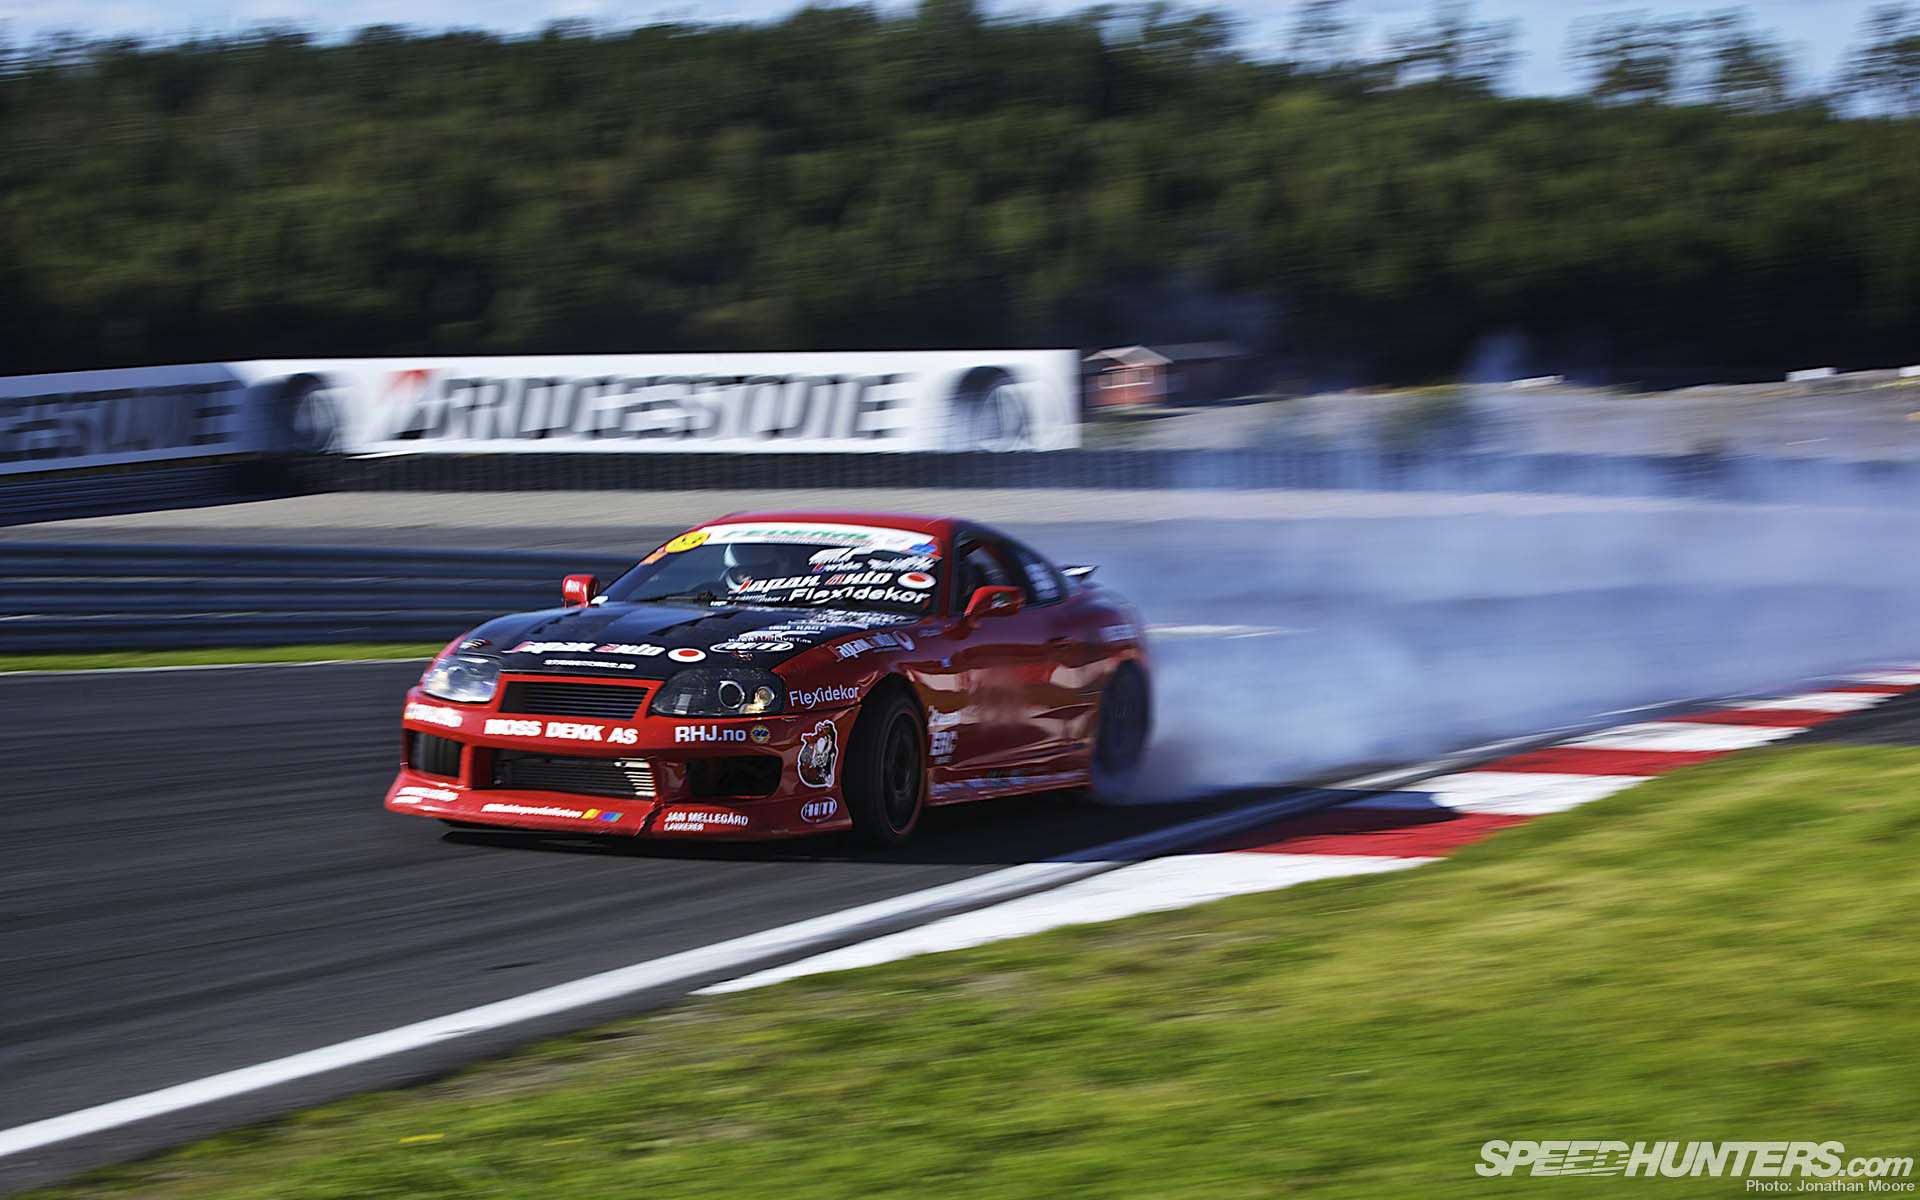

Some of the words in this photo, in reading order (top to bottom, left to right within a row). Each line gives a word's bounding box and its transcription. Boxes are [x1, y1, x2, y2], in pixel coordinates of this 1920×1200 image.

[788, 587, 932, 605] Flexidekor
[789, 684, 860, 710] Flexidekor
[484, 719, 542, 737] MOSS
[545, 722, 604, 741] DEKK
[607, 727, 638, 745] AS
[674, 725, 747, 743] RHJ.no
